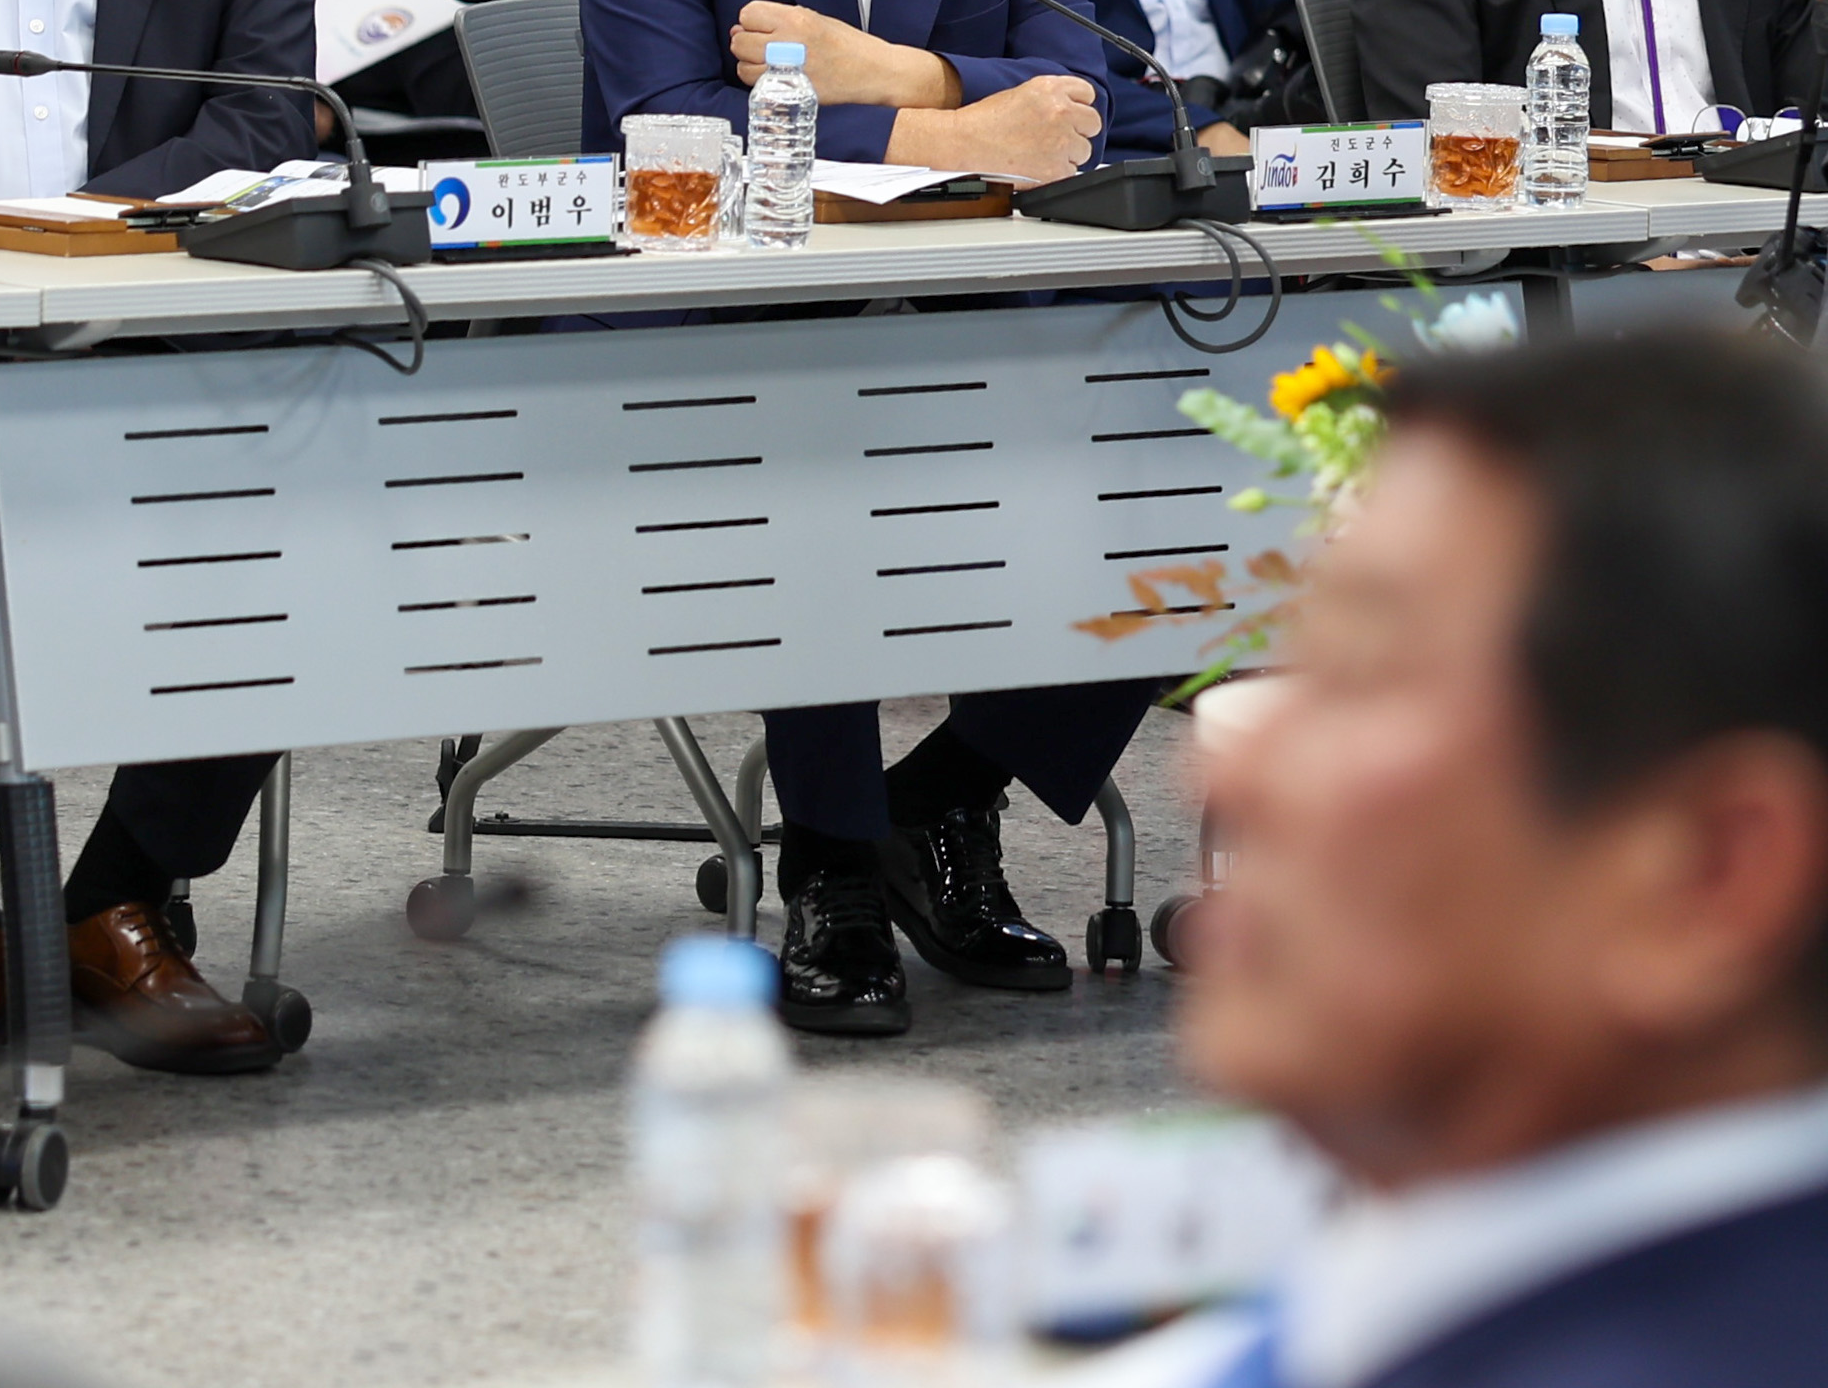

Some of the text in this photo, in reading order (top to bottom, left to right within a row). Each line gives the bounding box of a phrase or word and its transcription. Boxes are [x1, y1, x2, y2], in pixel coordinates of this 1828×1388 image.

[1330, 135, 1393, 152] 진도군수
[497, 170, 588, 189] 완도부군수
[1260, 159, 1292, 190] Jindo
[1315, 158, 1406, 191] 김희수
[491, 194, 593, 229] 이범우
